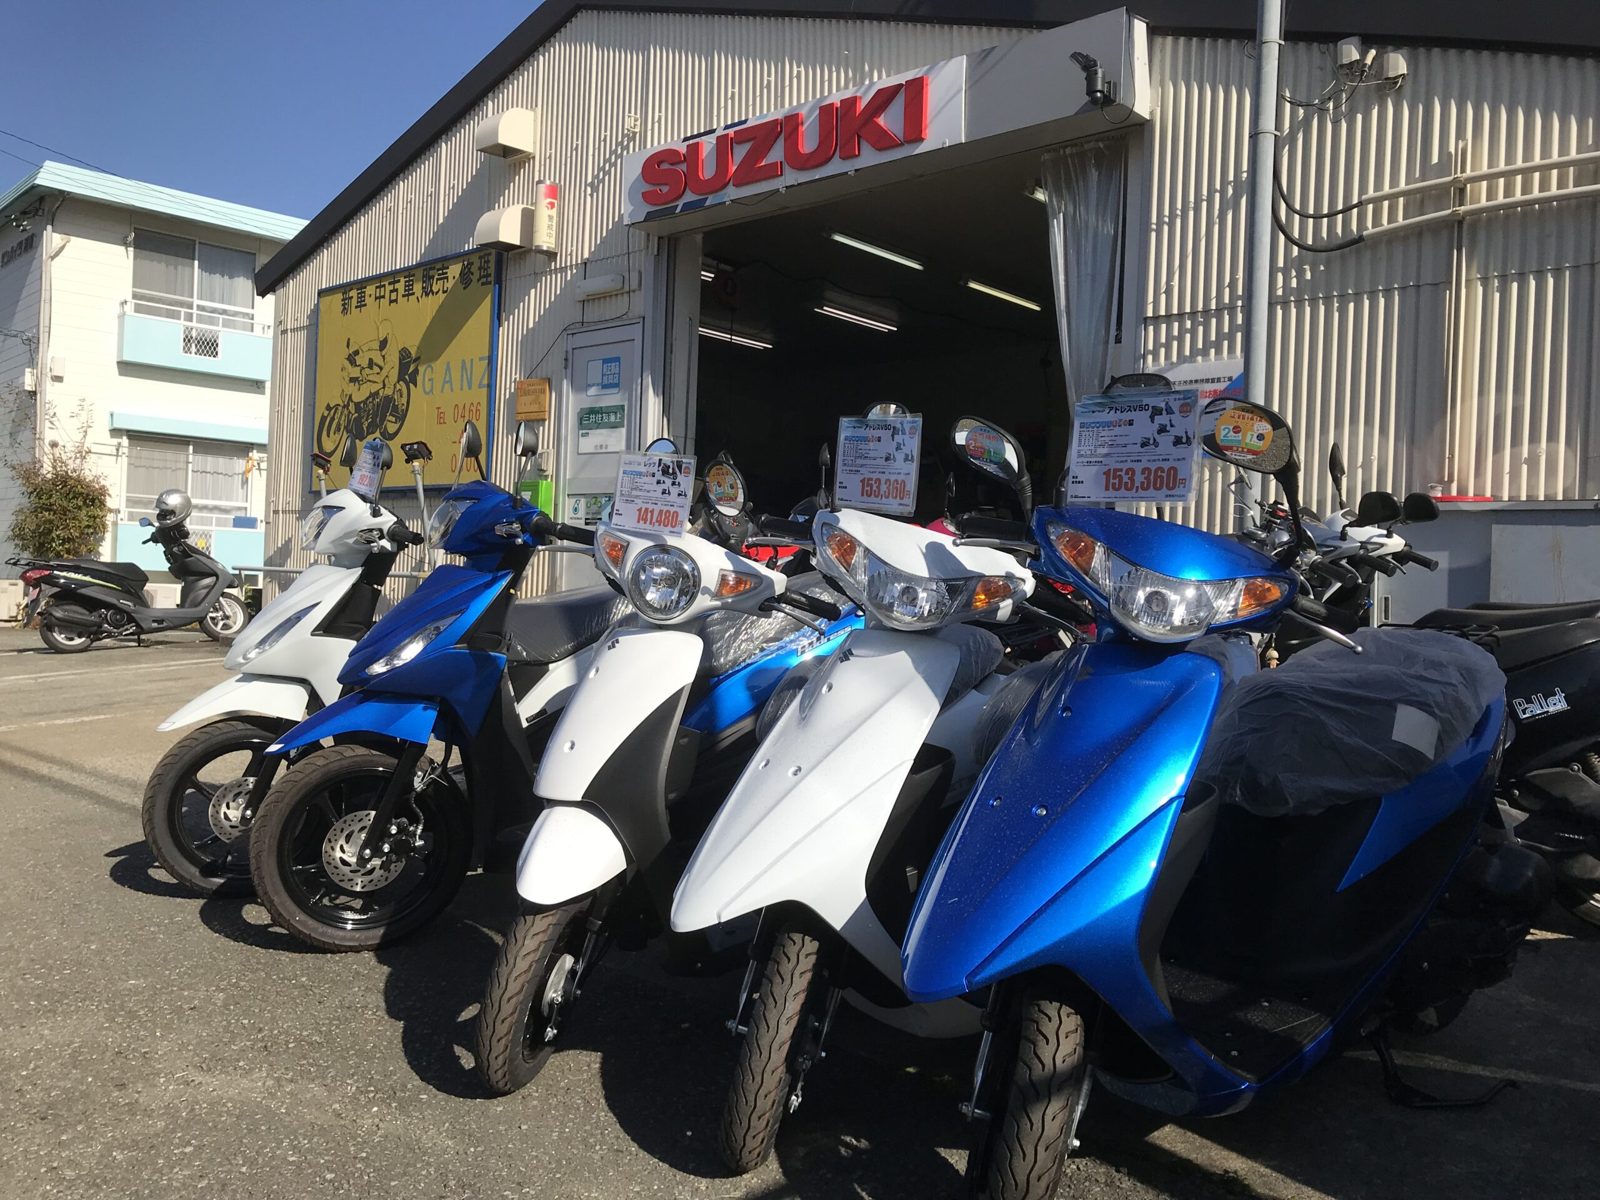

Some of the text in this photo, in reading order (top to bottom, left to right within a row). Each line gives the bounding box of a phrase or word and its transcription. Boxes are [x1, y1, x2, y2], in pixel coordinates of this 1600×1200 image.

[641, 75, 929, 206] SUZUKI
[422, 356, 491, 396] GANZ
[453, 402, 481, 424] 0466
[583, 411, 622, 424] 三井住友海上
[1107, 403, 1150, 415] アドレスV50
[1512, 687, 1568, 719] Pallet
